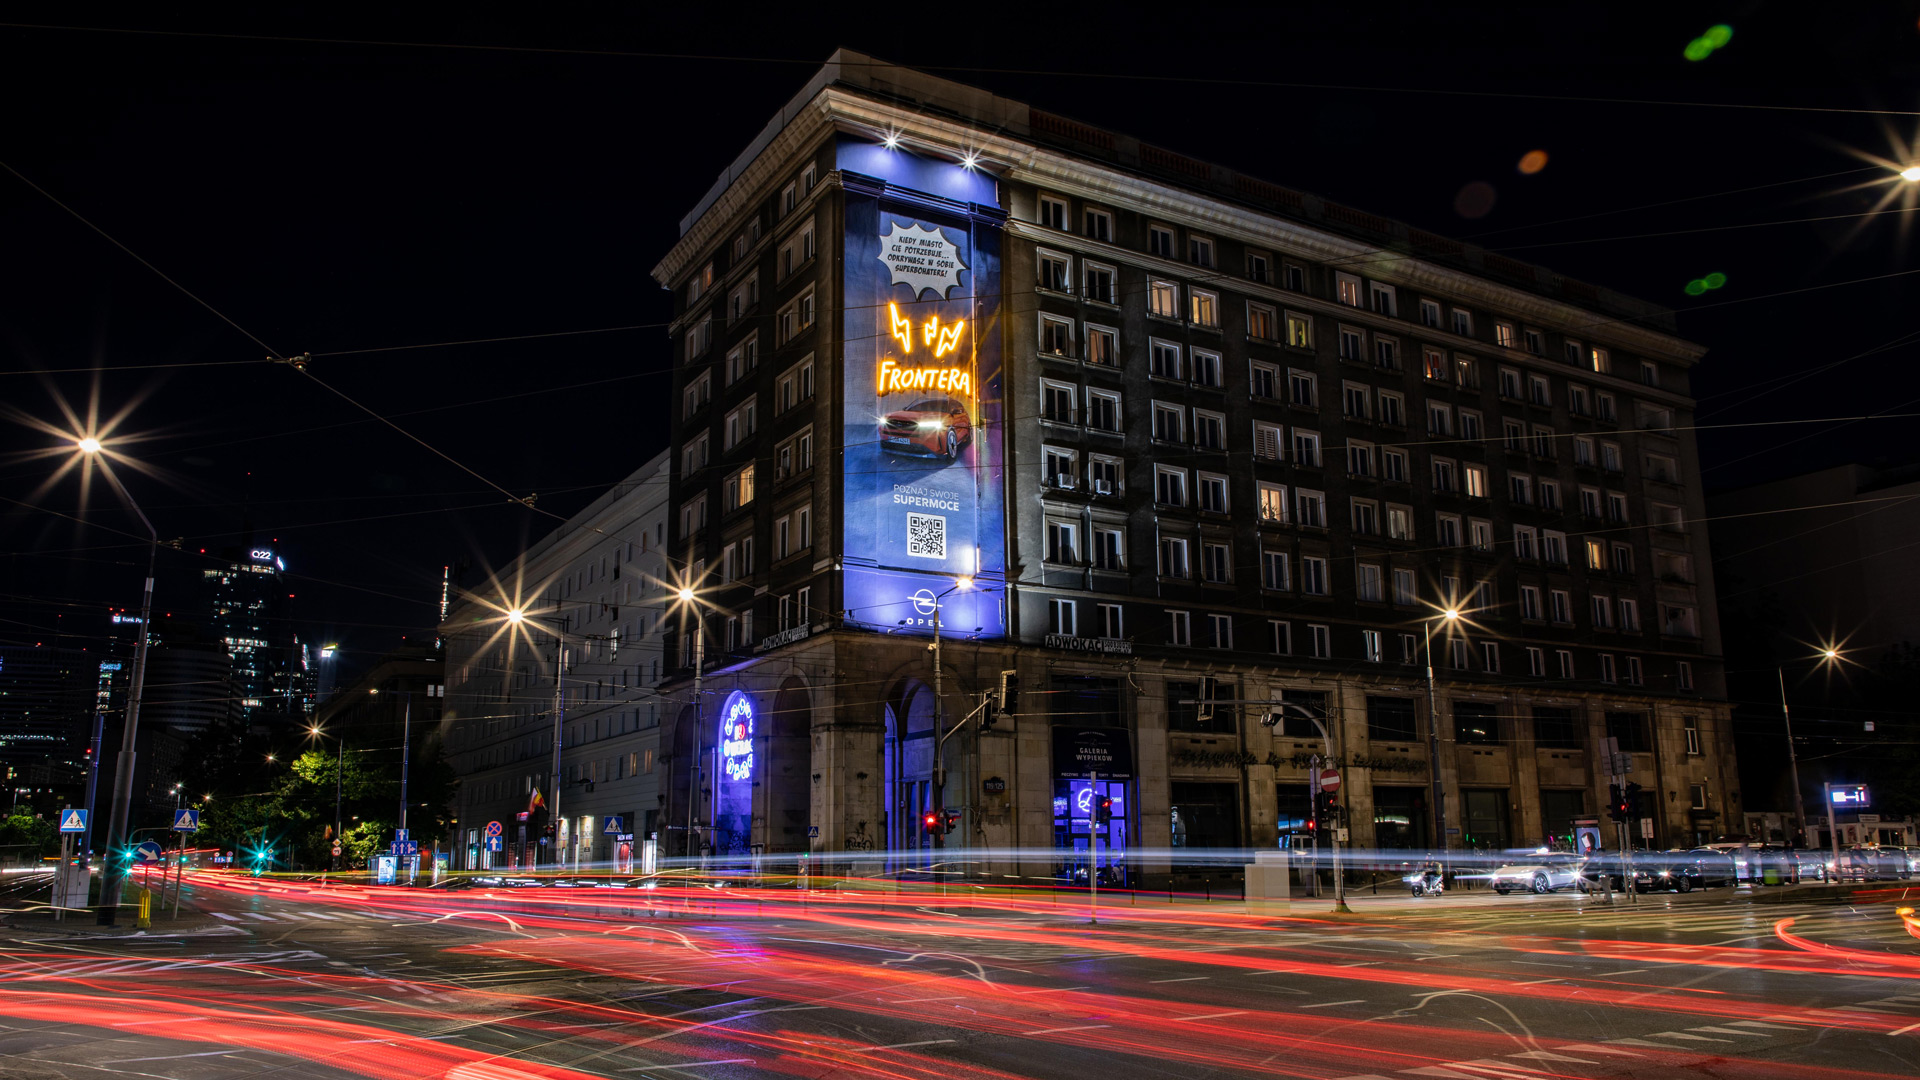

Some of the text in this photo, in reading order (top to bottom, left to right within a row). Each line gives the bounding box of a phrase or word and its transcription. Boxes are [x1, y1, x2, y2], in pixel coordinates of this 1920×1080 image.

[892, 244, 902, 253] CIĘ
[898, 236, 943, 249] KIEDY MIASTO
[887, 254, 925, 265] ODKRYWASZ
[936, 260, 954, 269] SOBIE
[893, 484, 959, 501] POZNAJ SWOJE
[893, 494, 960, 512] SUPERMOCE
[251, 550, 271, 560] Q22
[906, 617, 945, 628] OPEL
[1046, 635, 1104, 653] ADWOKACI
[1079, 747, 1108, 755] GALERIA
